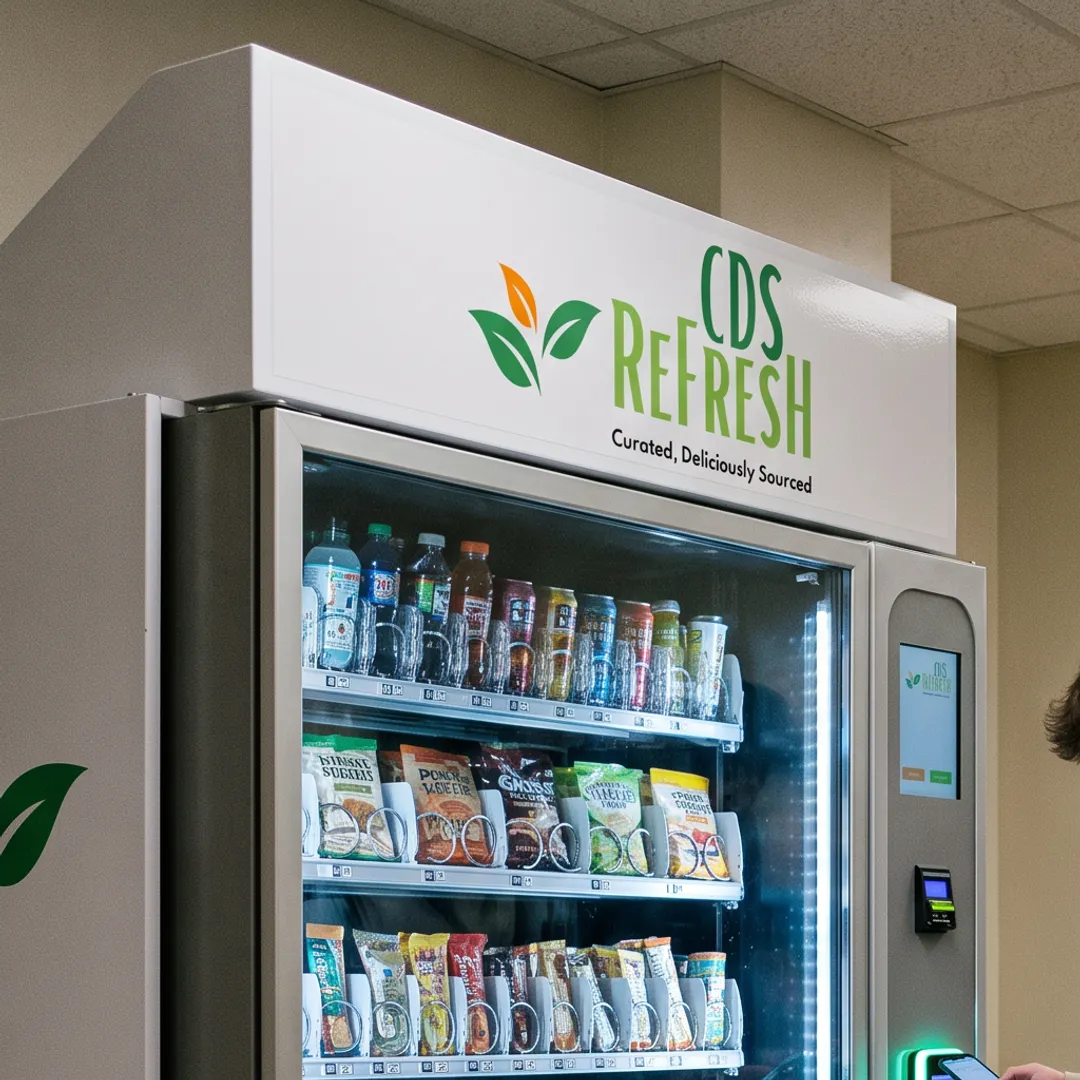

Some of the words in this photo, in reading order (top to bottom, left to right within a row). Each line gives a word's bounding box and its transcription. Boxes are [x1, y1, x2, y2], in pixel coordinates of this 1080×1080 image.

[701, 244, 784, 361] CDS
[612, 428, 678, 464] Curated,
[682, 445, 755, 484] Deliciously
[759, 464, 812, 494] Sourced
